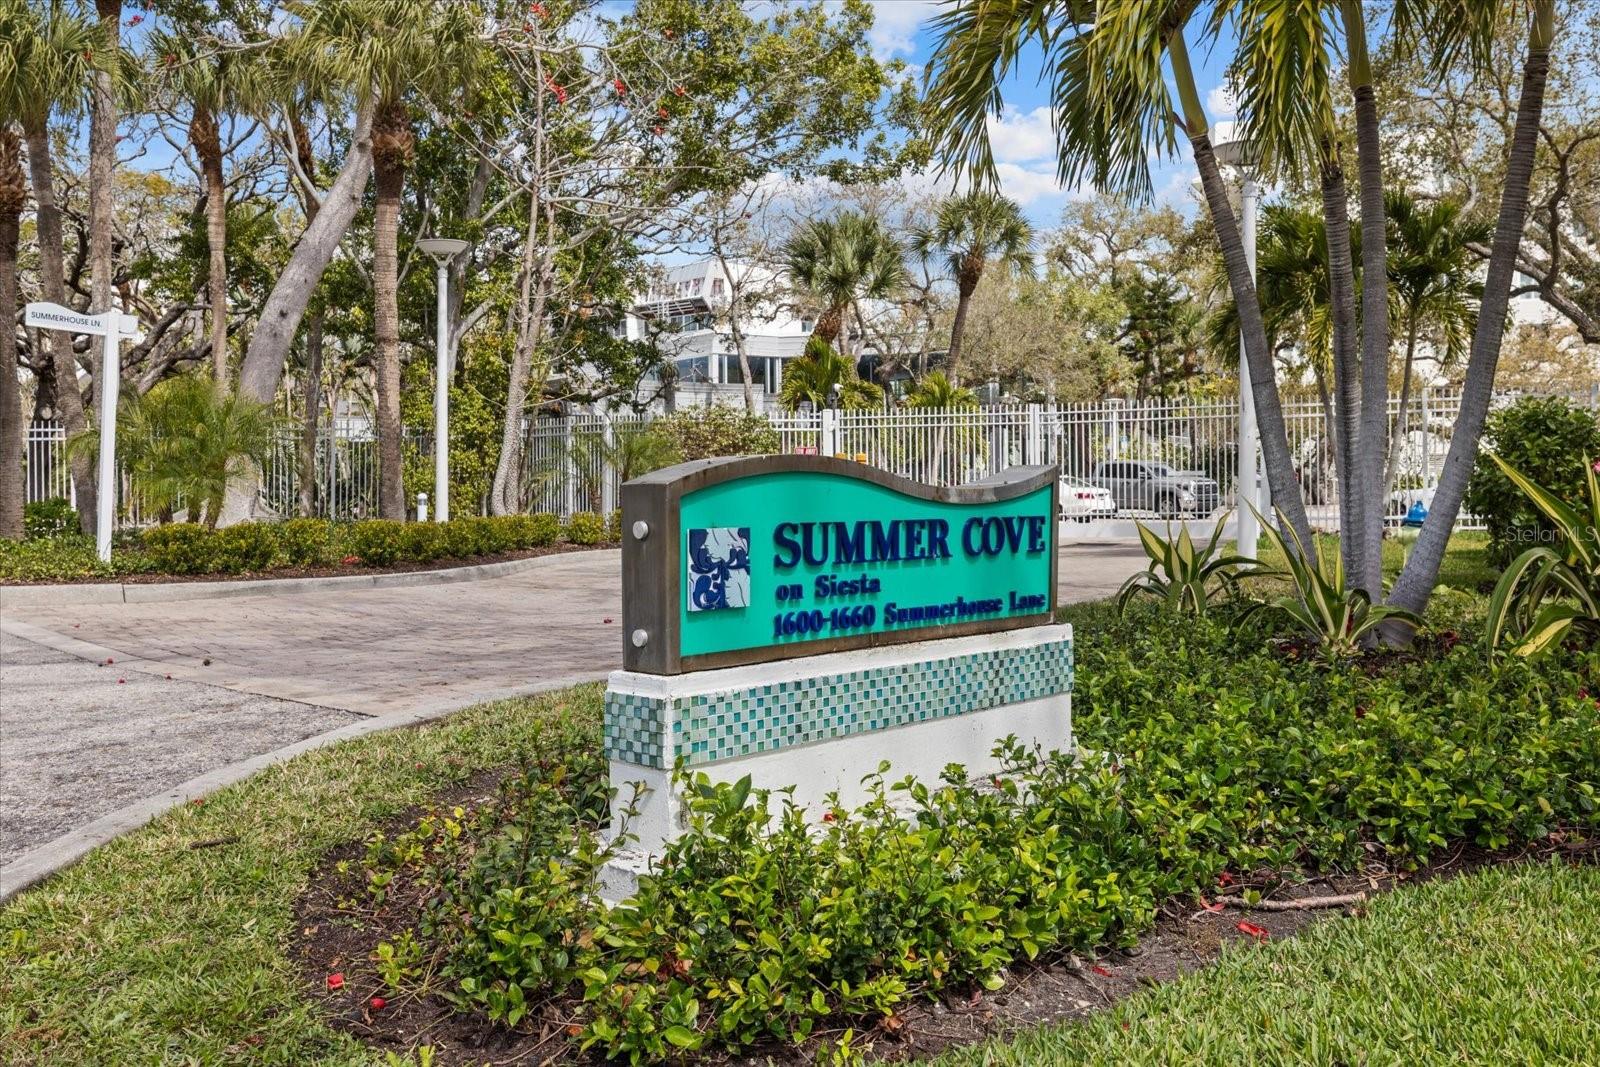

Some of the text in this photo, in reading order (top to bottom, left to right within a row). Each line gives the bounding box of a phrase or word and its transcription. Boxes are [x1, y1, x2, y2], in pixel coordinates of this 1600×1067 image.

[31, 311, 88, 325] SUMMERHOUSE
[773, 516, 1046, 567] SUMMER COVE
[776, 573, 881, 600] on Siesta
[773, 591, 1046, 637] 1600-1660 Summerhouse Lane
